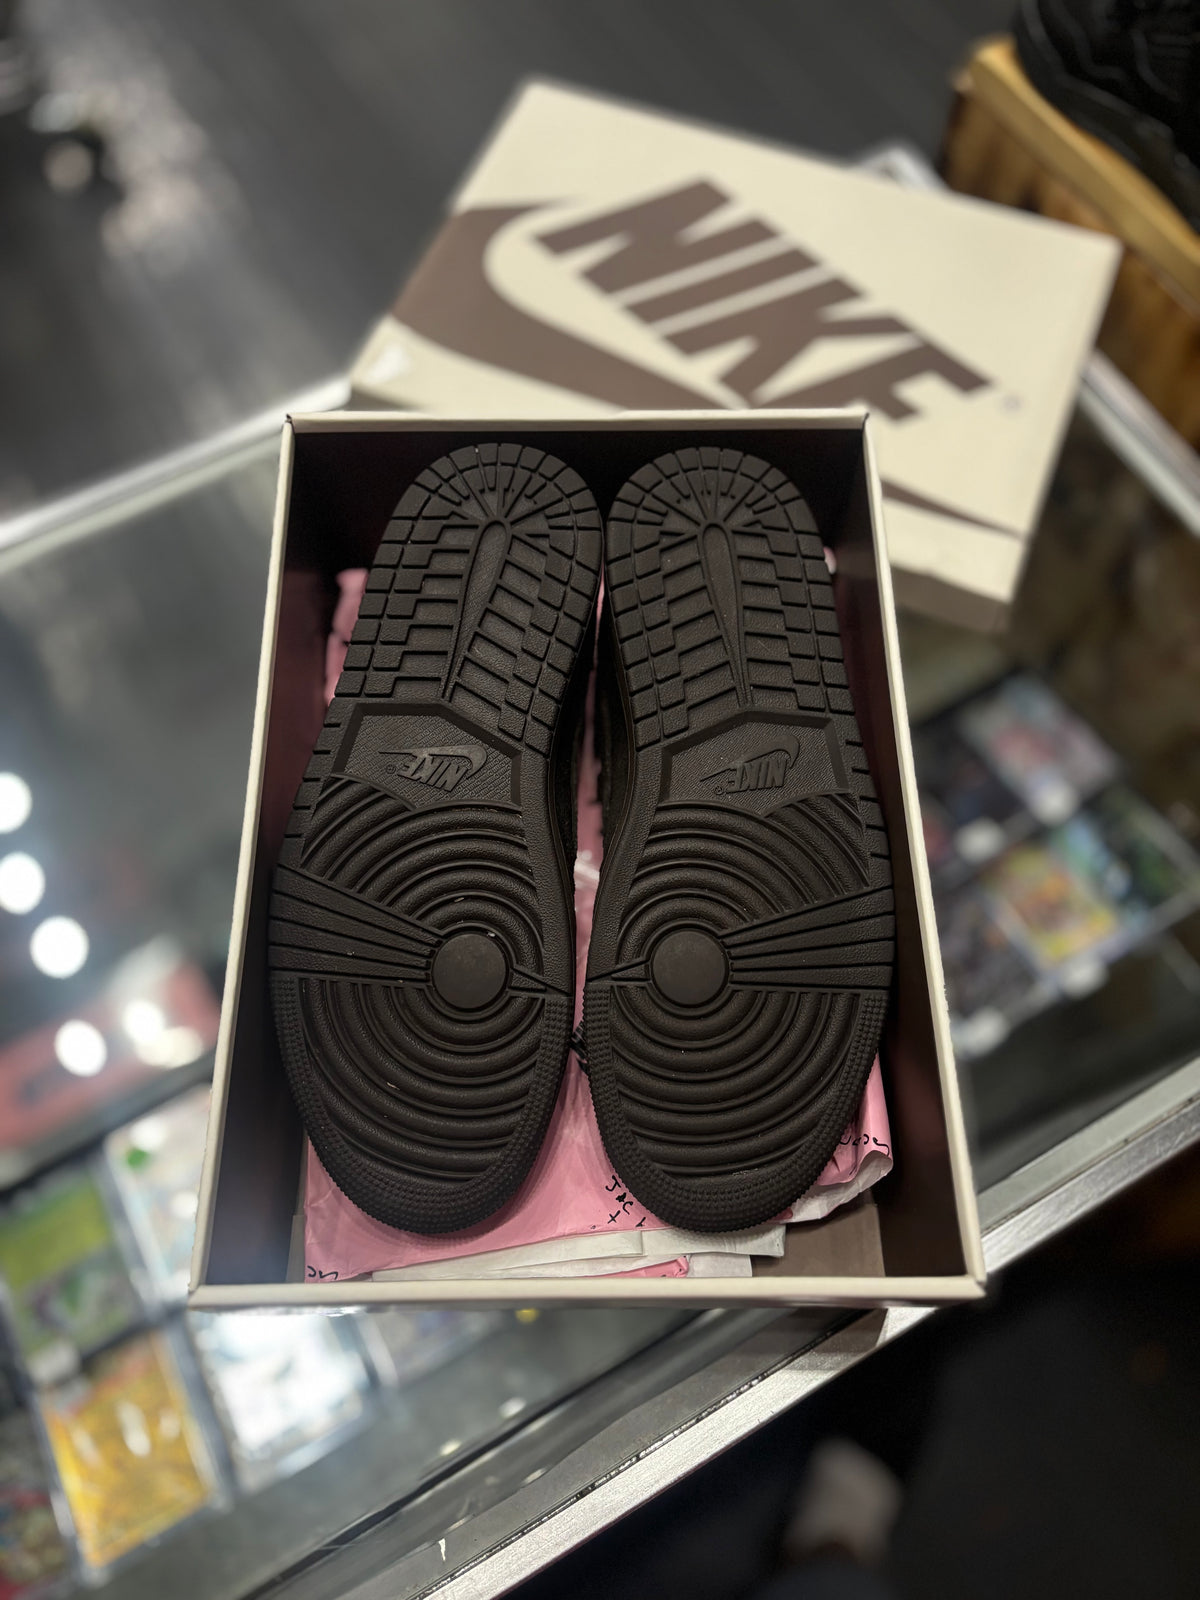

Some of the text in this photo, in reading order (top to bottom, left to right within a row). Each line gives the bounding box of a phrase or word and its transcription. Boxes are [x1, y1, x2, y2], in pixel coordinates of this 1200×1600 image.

[535, 179, 992, 421] NIKE
[397, 756, 469, 792] NIKE
[725, 758, 788, 794] NIKE
